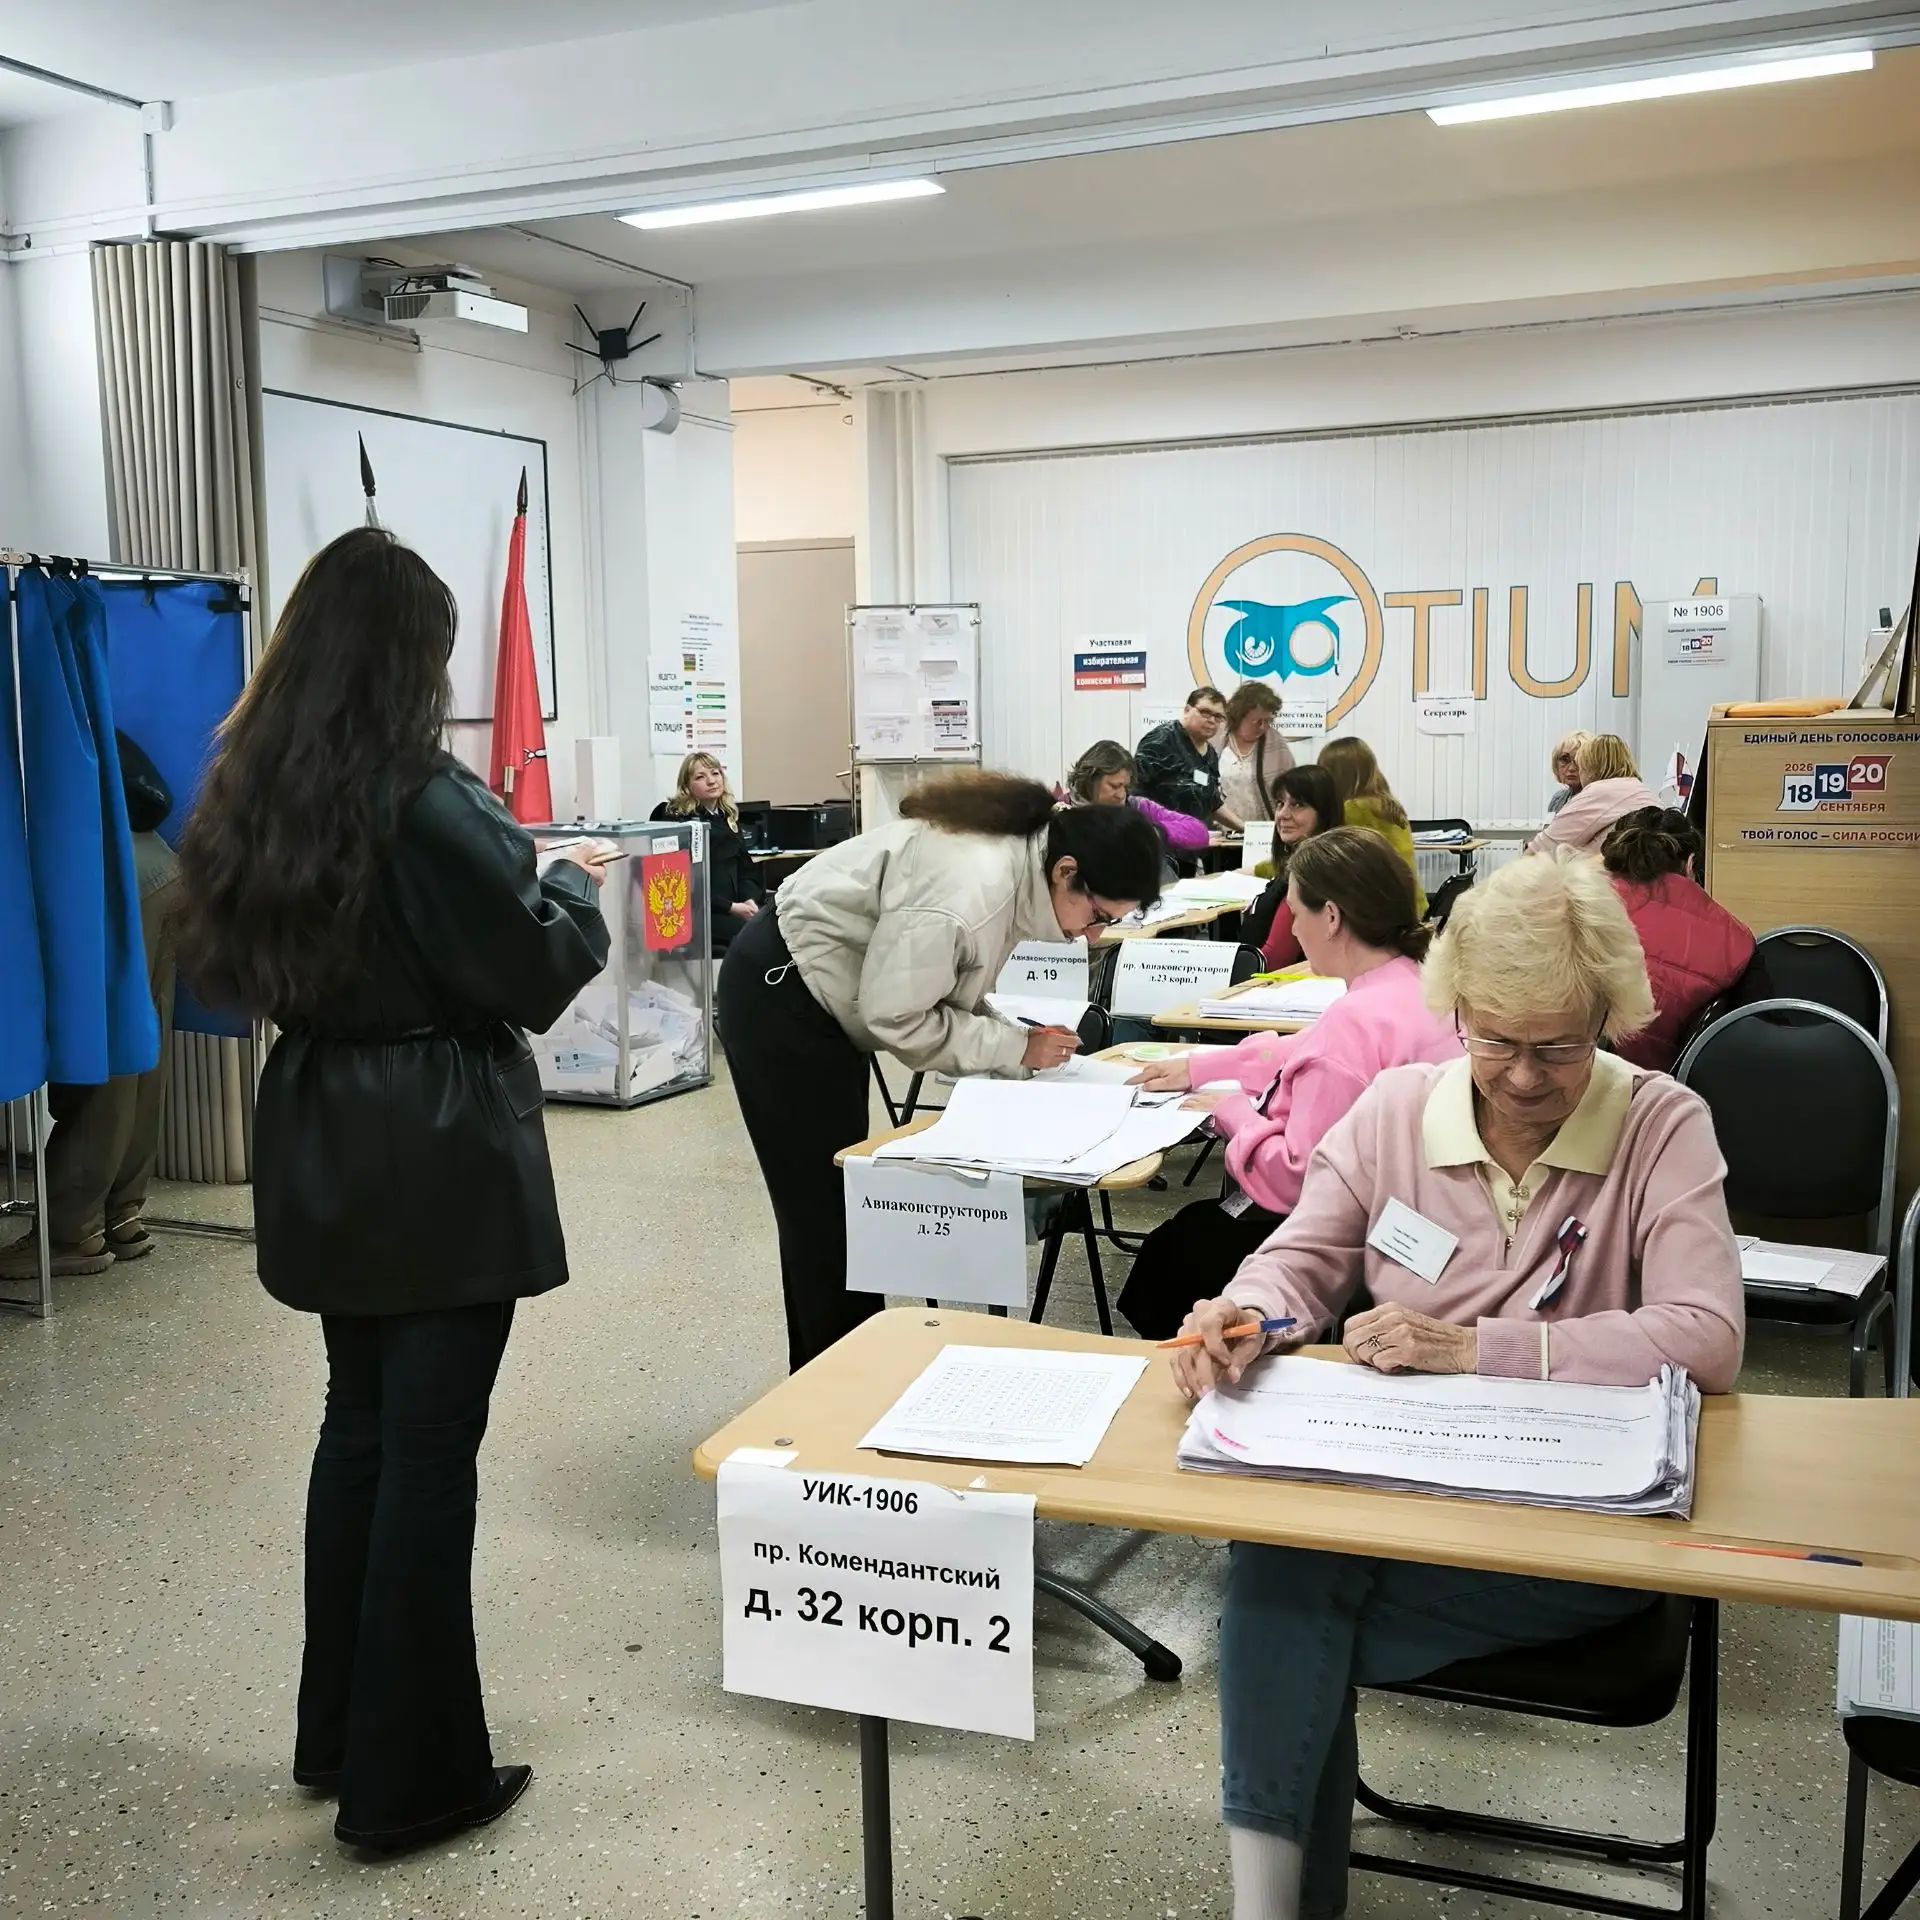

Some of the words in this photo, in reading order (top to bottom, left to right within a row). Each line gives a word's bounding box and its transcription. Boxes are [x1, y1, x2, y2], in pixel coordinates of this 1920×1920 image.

[1694, 605, 1724, 617] 1906
[1082, 656, 1139, 667] избирательная
[1423, 708, 1467, 718] Секретарь
[1744, 732, 1797, 745] ЕДИНЫЙ
[1799, 732, 1834, 744] ДЕНЬ
[1784, 763, 1813, 772] 2026
[1850, 763, 1884, 784] 20
[1818, 773, 1845, 793] 19
[1787, 784, 1813, 803] 18
[1820, 803, 1886, 812] СЕНТЯБРЯ
[1741, 828, 1774, 840] ТВОЙ
[1777, 831, 1818, 841] ГОЛОС
[1832, 831, 1867, 841] СИЛА
[1870, 831, 1920, 841] РОССИИ
[1010, 954, 1087, 965] Авиаконструкторов
[1026, 970, 1038, 981] д.
[1043, 969, 1058, 981] 19
[1123, 962, 1136, 971] пр.
[1139, 962, 1229, 975] Авиаконструкторов
[861, 1195, 1009, 1222] Авиаконструкторов
[917, 1223, 930, 1236] д.
[934, 1222, 951, 1237] 25
[1503, 1434, 1562, 1444] КНИГА
[802, 1479, 919, 1514] УИК-1906
[753, 1542, 790, 1564] пр.
[799, 1543, 1000, 1590] Комендантский
[744, 1587, 782, 1622] д.
[797, 1587, 844, 1627] 32
[858, 1604, 973, 1649] корп.
[988, 1616, 1011, 1653] 2
